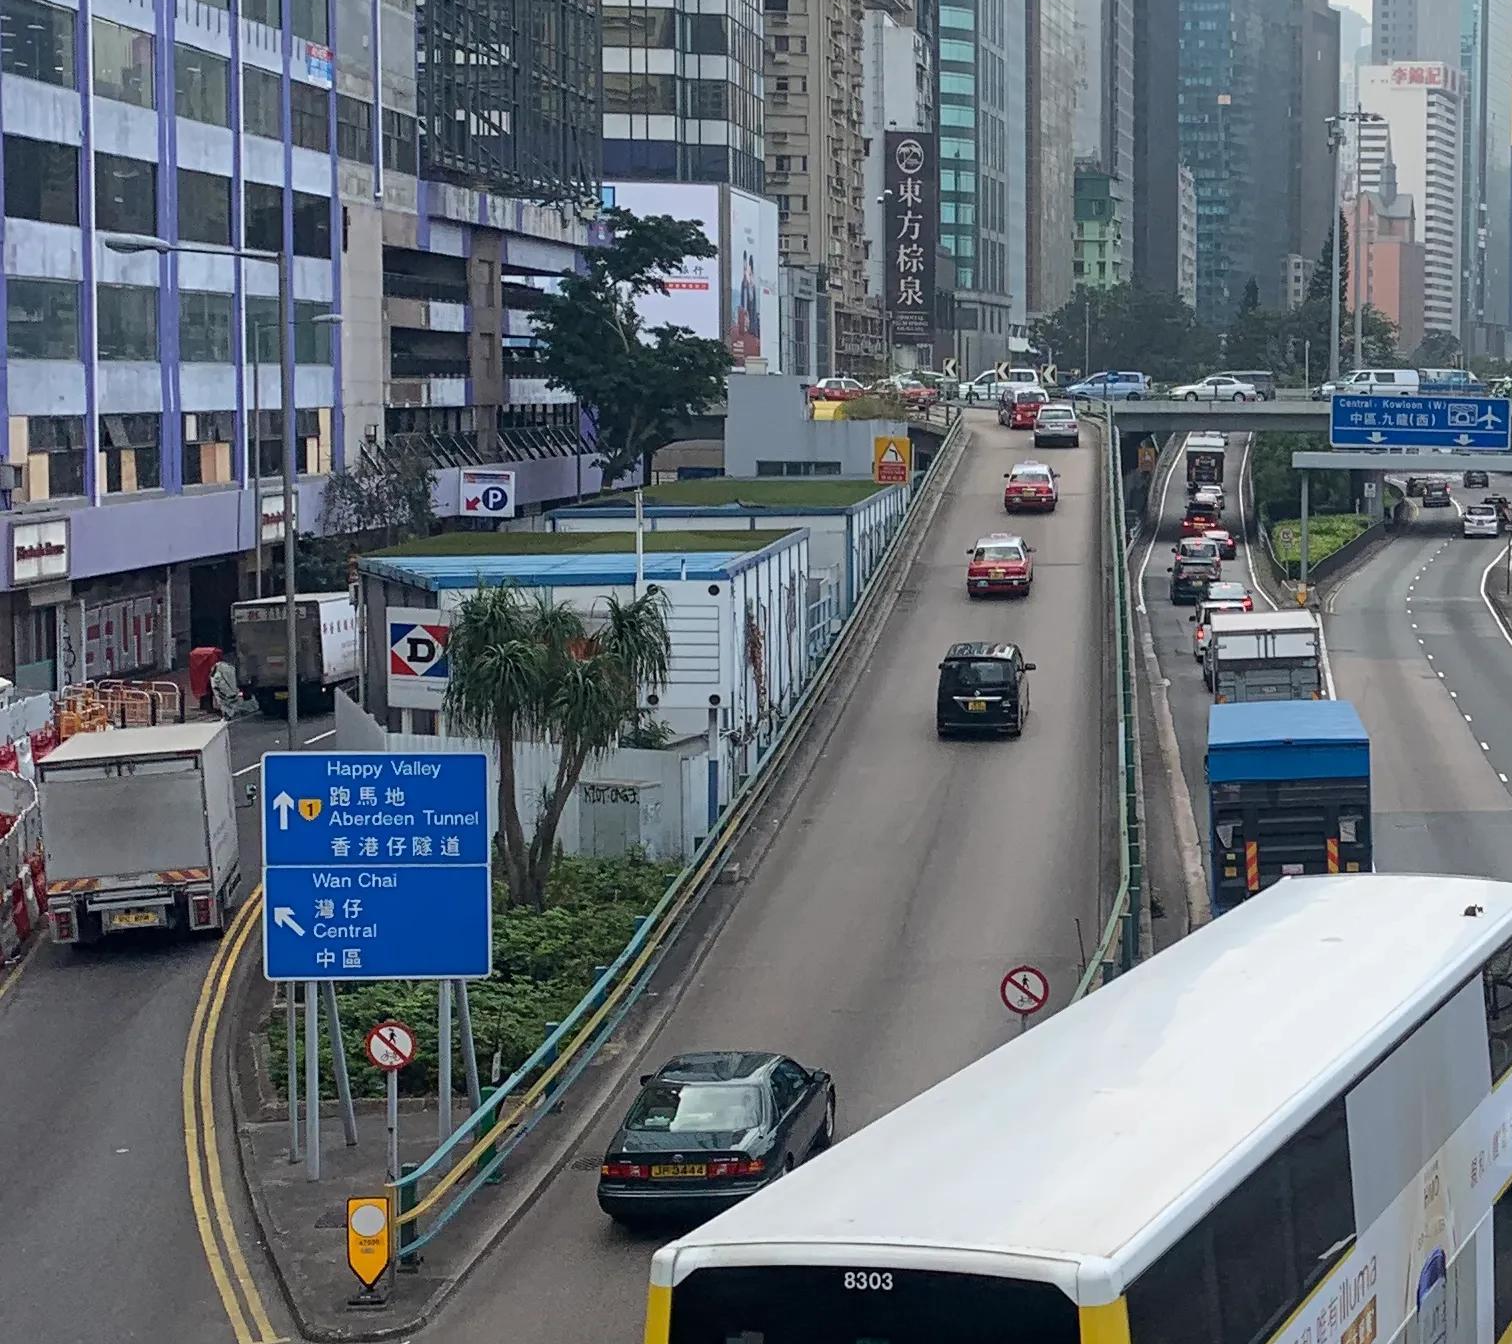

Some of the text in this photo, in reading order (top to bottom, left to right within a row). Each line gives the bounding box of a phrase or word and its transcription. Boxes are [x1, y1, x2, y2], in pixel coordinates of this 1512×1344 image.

[1391, 66, 1443, 85] 李錦記
[897, 177, 925, 306] 東方棕泉
[1382, 399, 1423, 410] Kowloon
[1428, 399, 1448, 411] (W)
[488, 489, 503, 509] P
[406, 638, 436, 663] D
[327, 760, 441, 779] Happy Valley
[330, 787, 406, 807] 跑馬地
[328, 810, 479, 827] Aberdeen Tunnel
[331, 836, 461, 857] 香港仔隧道
[312, 873, 397, 888] Wan Chai
[314, 899, 363, 919] 灣仔
[313, 924, 377, 938] Central
[316, 948, 362, 969] 中區
[843, 1272, 894, 1291] 8303
